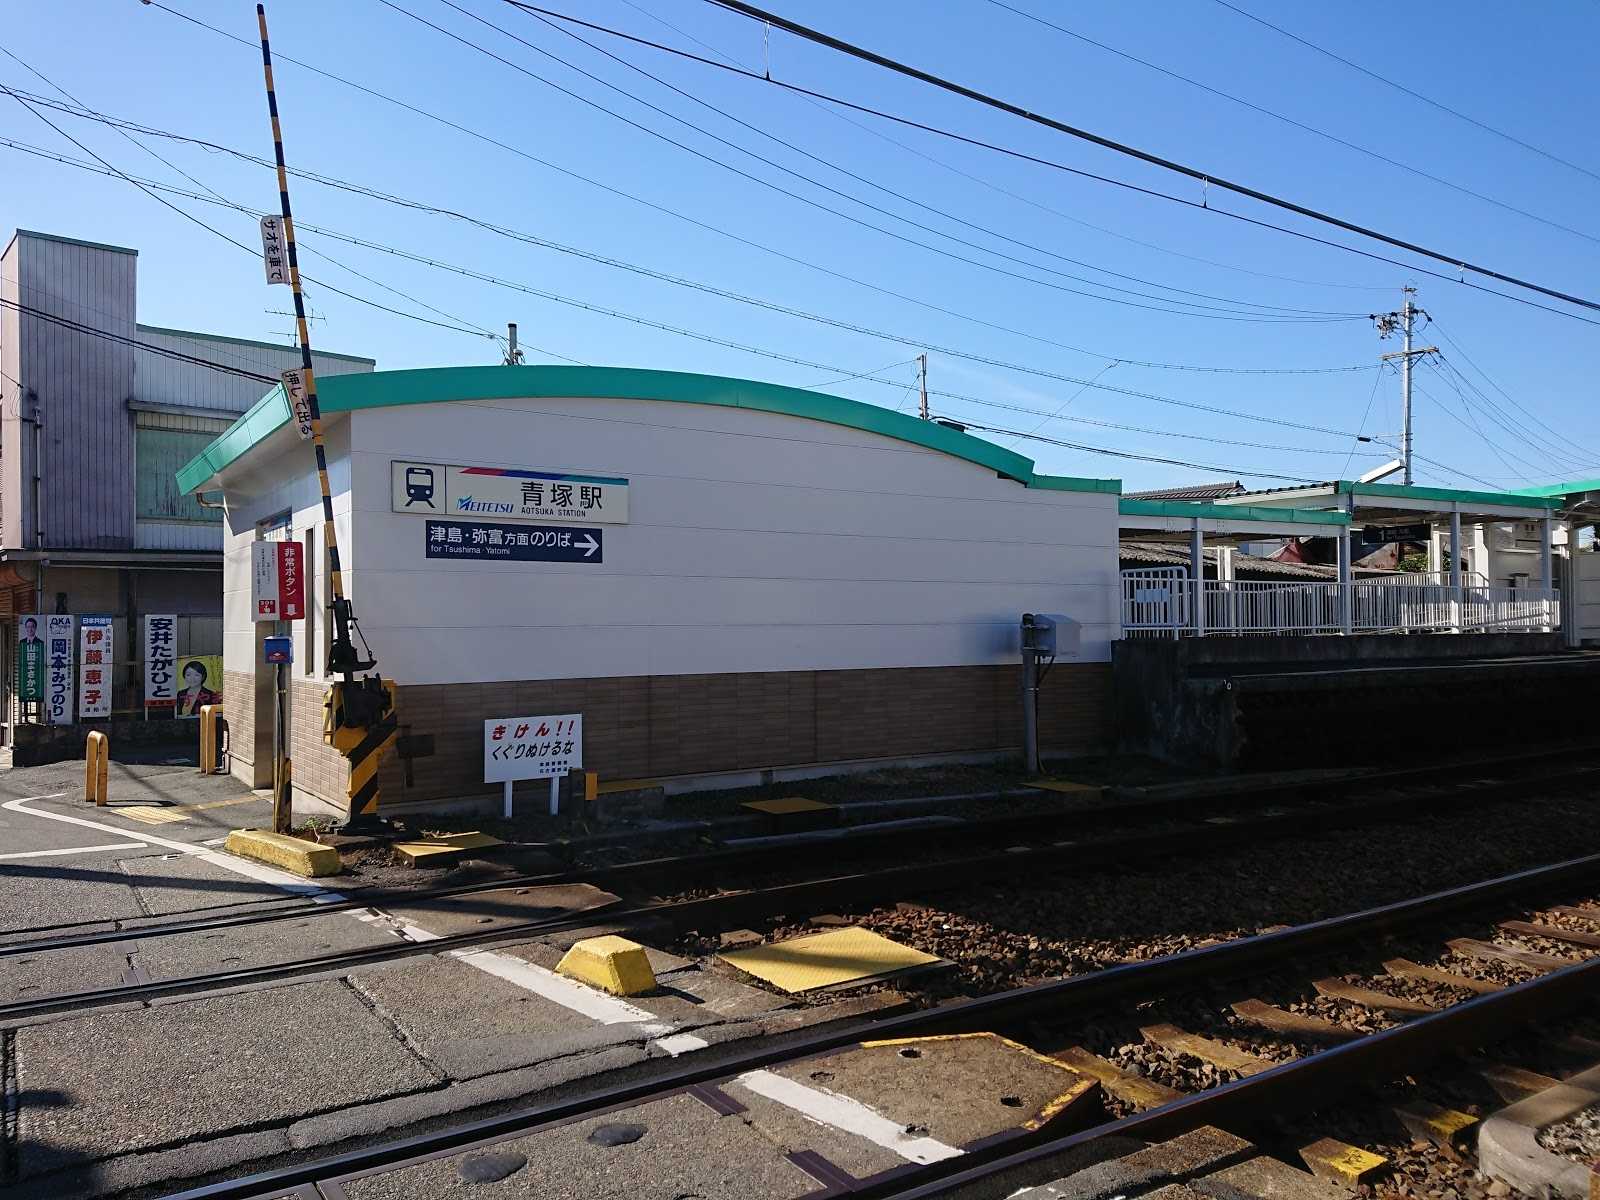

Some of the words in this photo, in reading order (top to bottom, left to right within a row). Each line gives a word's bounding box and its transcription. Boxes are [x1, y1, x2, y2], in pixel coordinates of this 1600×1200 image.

[264, 219, 283, 280] サオを車で
[285, 372, 313, 435] 押して出る
[520, 481, 603, 510] 青塚駅
[521, 506, 554, 516] AOTSUKA
[558, 509, 587, 518] STATION
[284, 548, 296, 596] 非常ボタン
[430, 544, 443, 553] for
[444, 545, 481, 554] Tsushima
[485, 547, 511, 555] Yatomi
[51, 638, 67, 717] 岡本みつのり
[85, 629, 103, 705] 伊藤恵子
[492, 740, 575, 760] くぐりぬけるな
